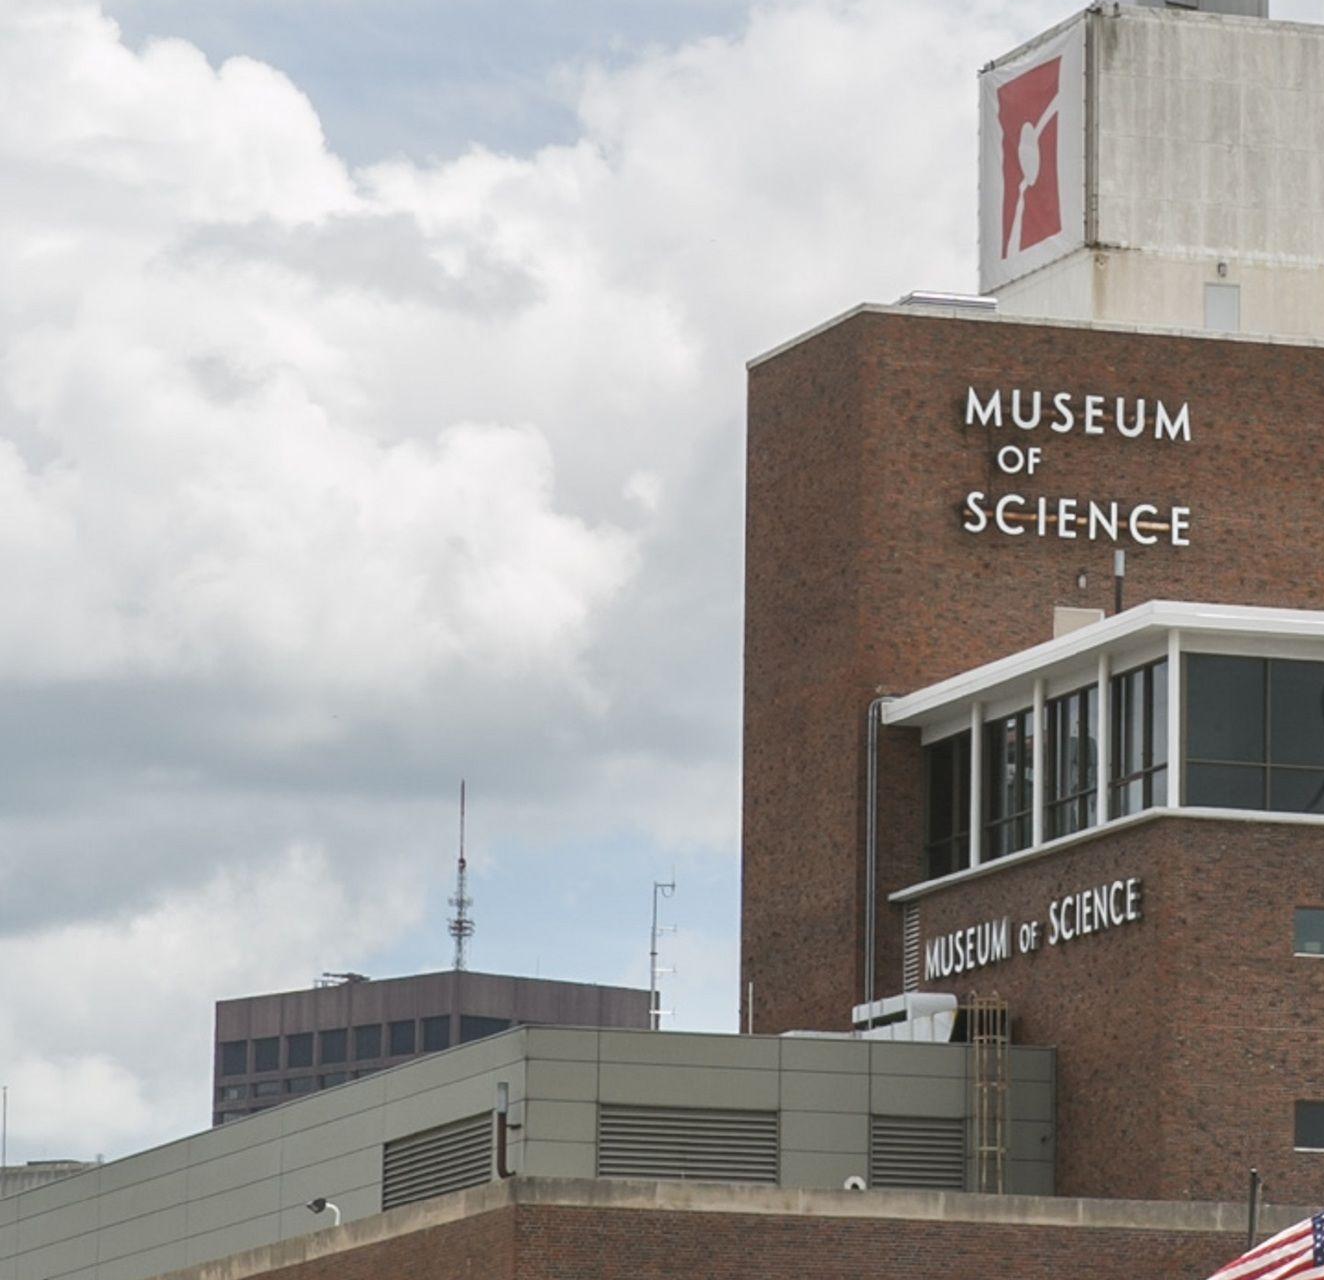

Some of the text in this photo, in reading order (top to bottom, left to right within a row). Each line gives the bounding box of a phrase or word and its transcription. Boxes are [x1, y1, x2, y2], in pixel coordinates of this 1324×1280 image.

[966, 386, 1191, 441] MUSEUM
[997, 445, 1041, 475] OF
[964, 491, 1190, 546] SCIENCE
[924, 877, 1142, 981] MUSEUM OF SCIENCE
